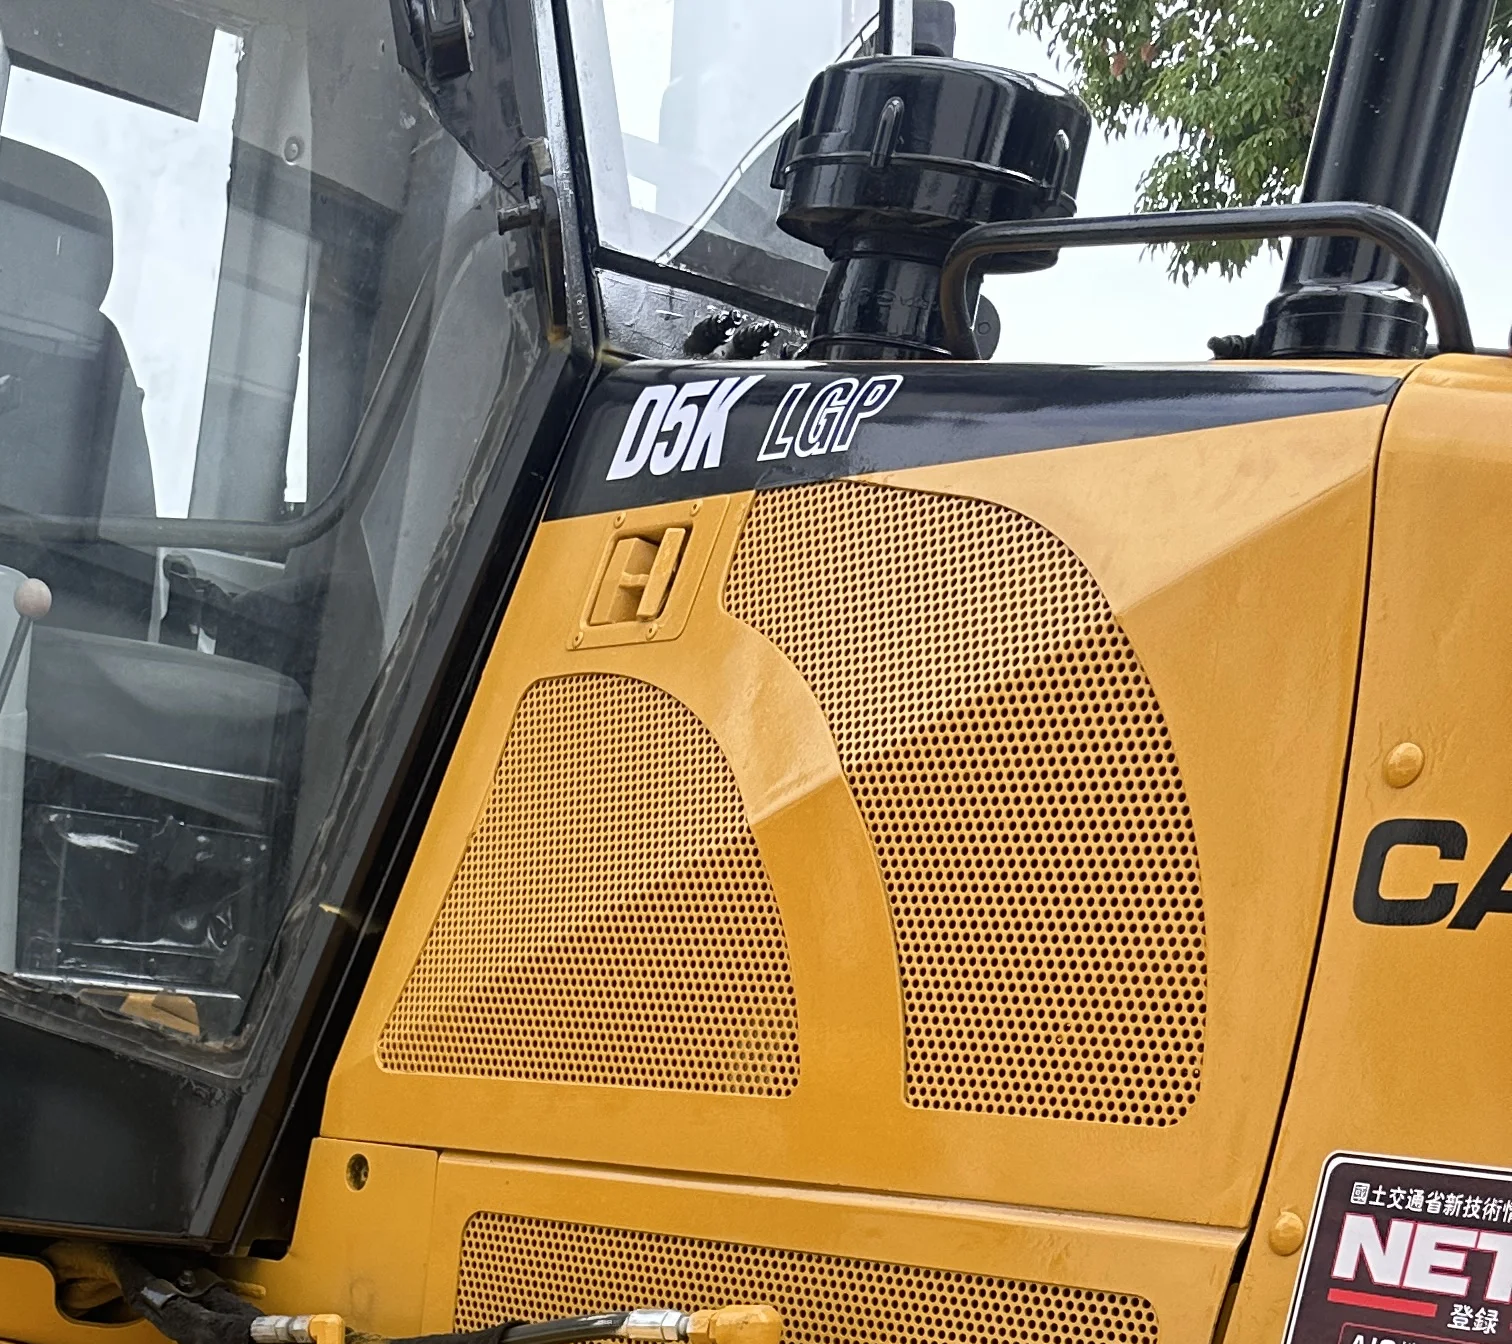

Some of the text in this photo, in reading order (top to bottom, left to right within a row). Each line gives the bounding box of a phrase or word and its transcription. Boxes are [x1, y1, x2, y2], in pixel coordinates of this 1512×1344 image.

[606, 374, 904, 481] D5K LGP
[1446, 1303, 1500, 1335] 登録
